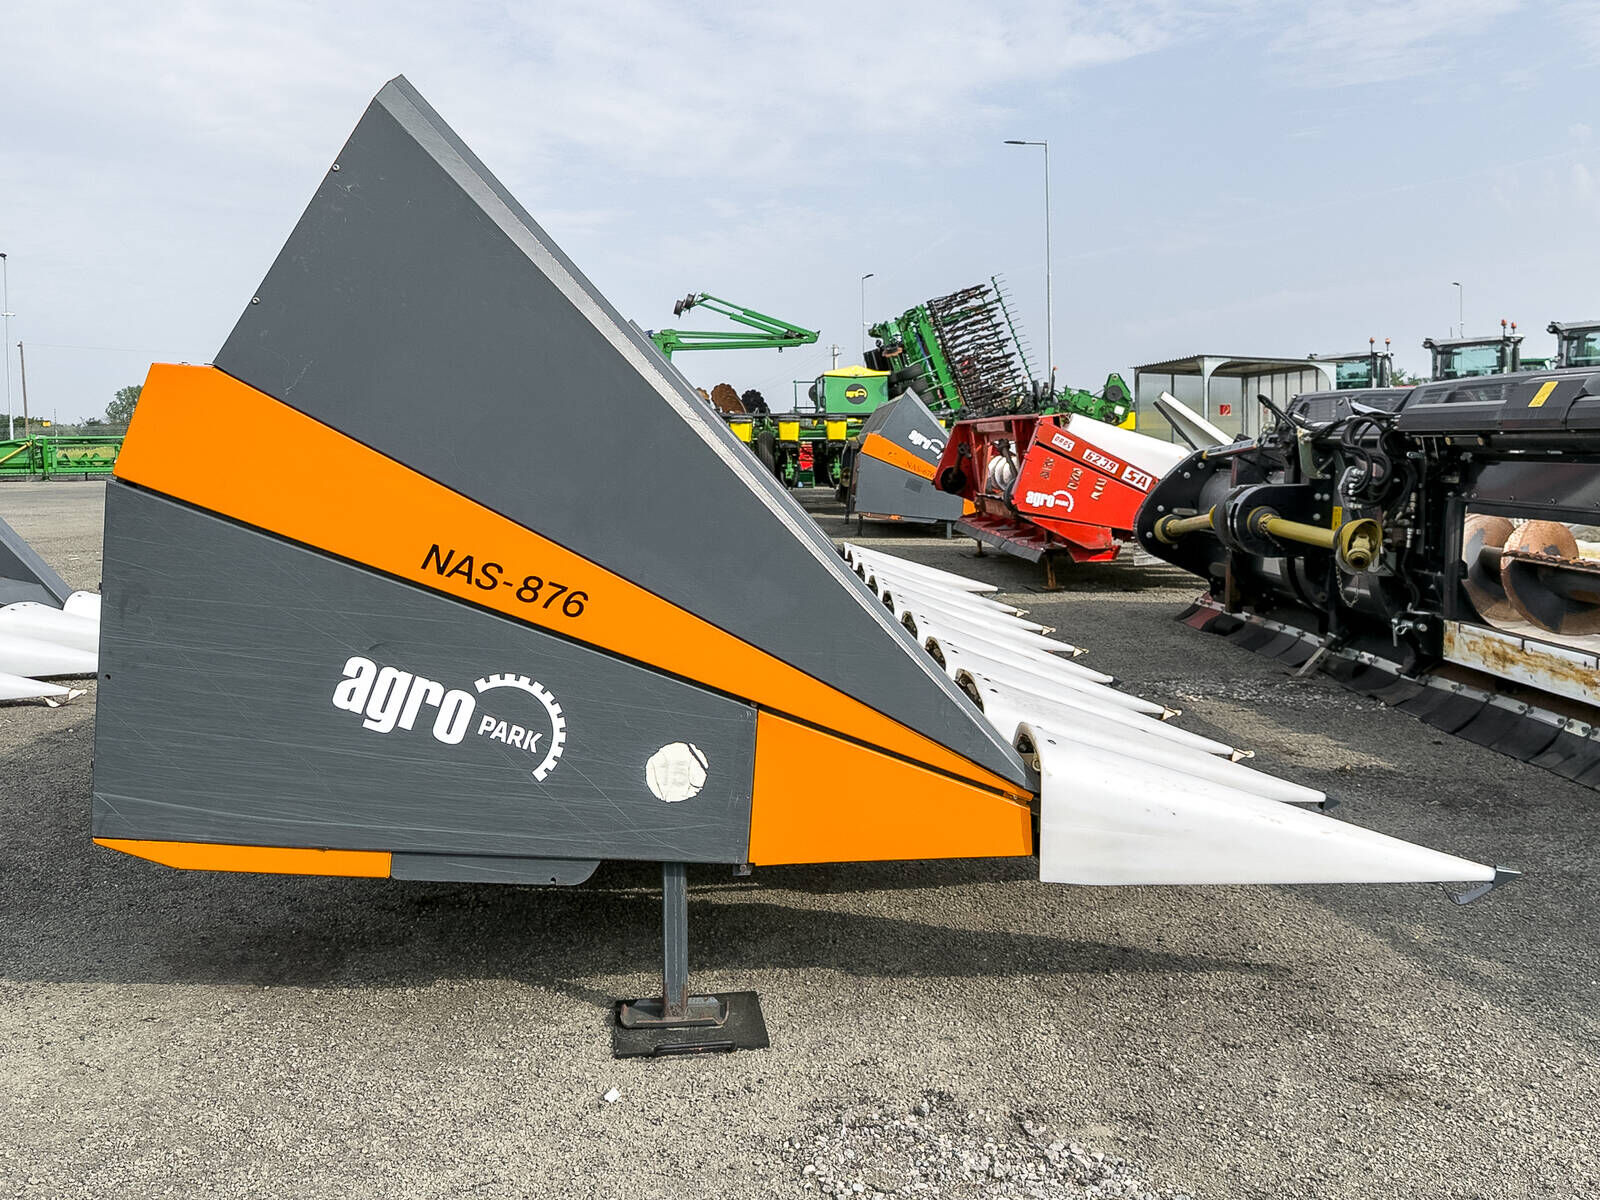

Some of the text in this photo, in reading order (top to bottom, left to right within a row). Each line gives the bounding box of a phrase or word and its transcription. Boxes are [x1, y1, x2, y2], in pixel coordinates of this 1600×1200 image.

[1025, 490, 1055, 508] agro
[1124, 470, 1148, 488] SA
[420, 543, 589, 618] NAS-876
[332, 655, 543, 754] agro PARK
